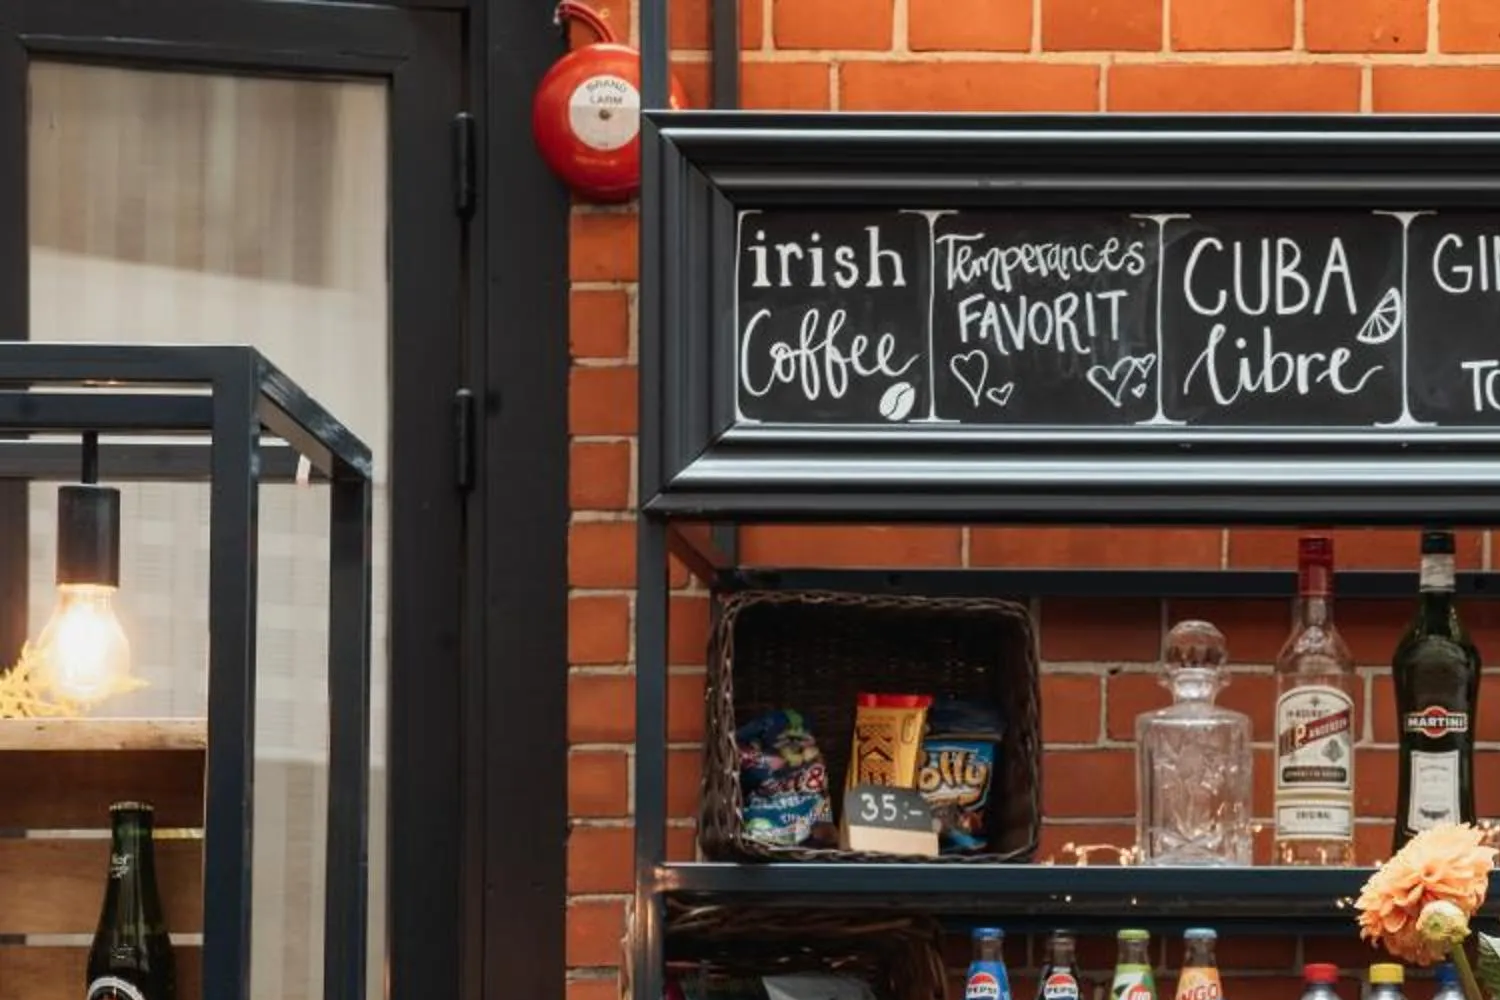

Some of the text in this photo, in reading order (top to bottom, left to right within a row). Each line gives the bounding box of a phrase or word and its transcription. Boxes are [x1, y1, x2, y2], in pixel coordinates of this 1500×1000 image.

[747, 226, 907, 288] irish
[935, 232, 1146, 290] Temperances
[1183, 237, 1358, 316] CUBA
[958, 291, 1128, 355] FAVORIT
[741, 308, 920, 400] Coffee
[1407, 716, 1466, 729] MARTINI
[861, 793, 923, 822] 35:-
[967, 986, 998, 995] PEPSI
[1046, 987, 1077, 996] PEPSI
